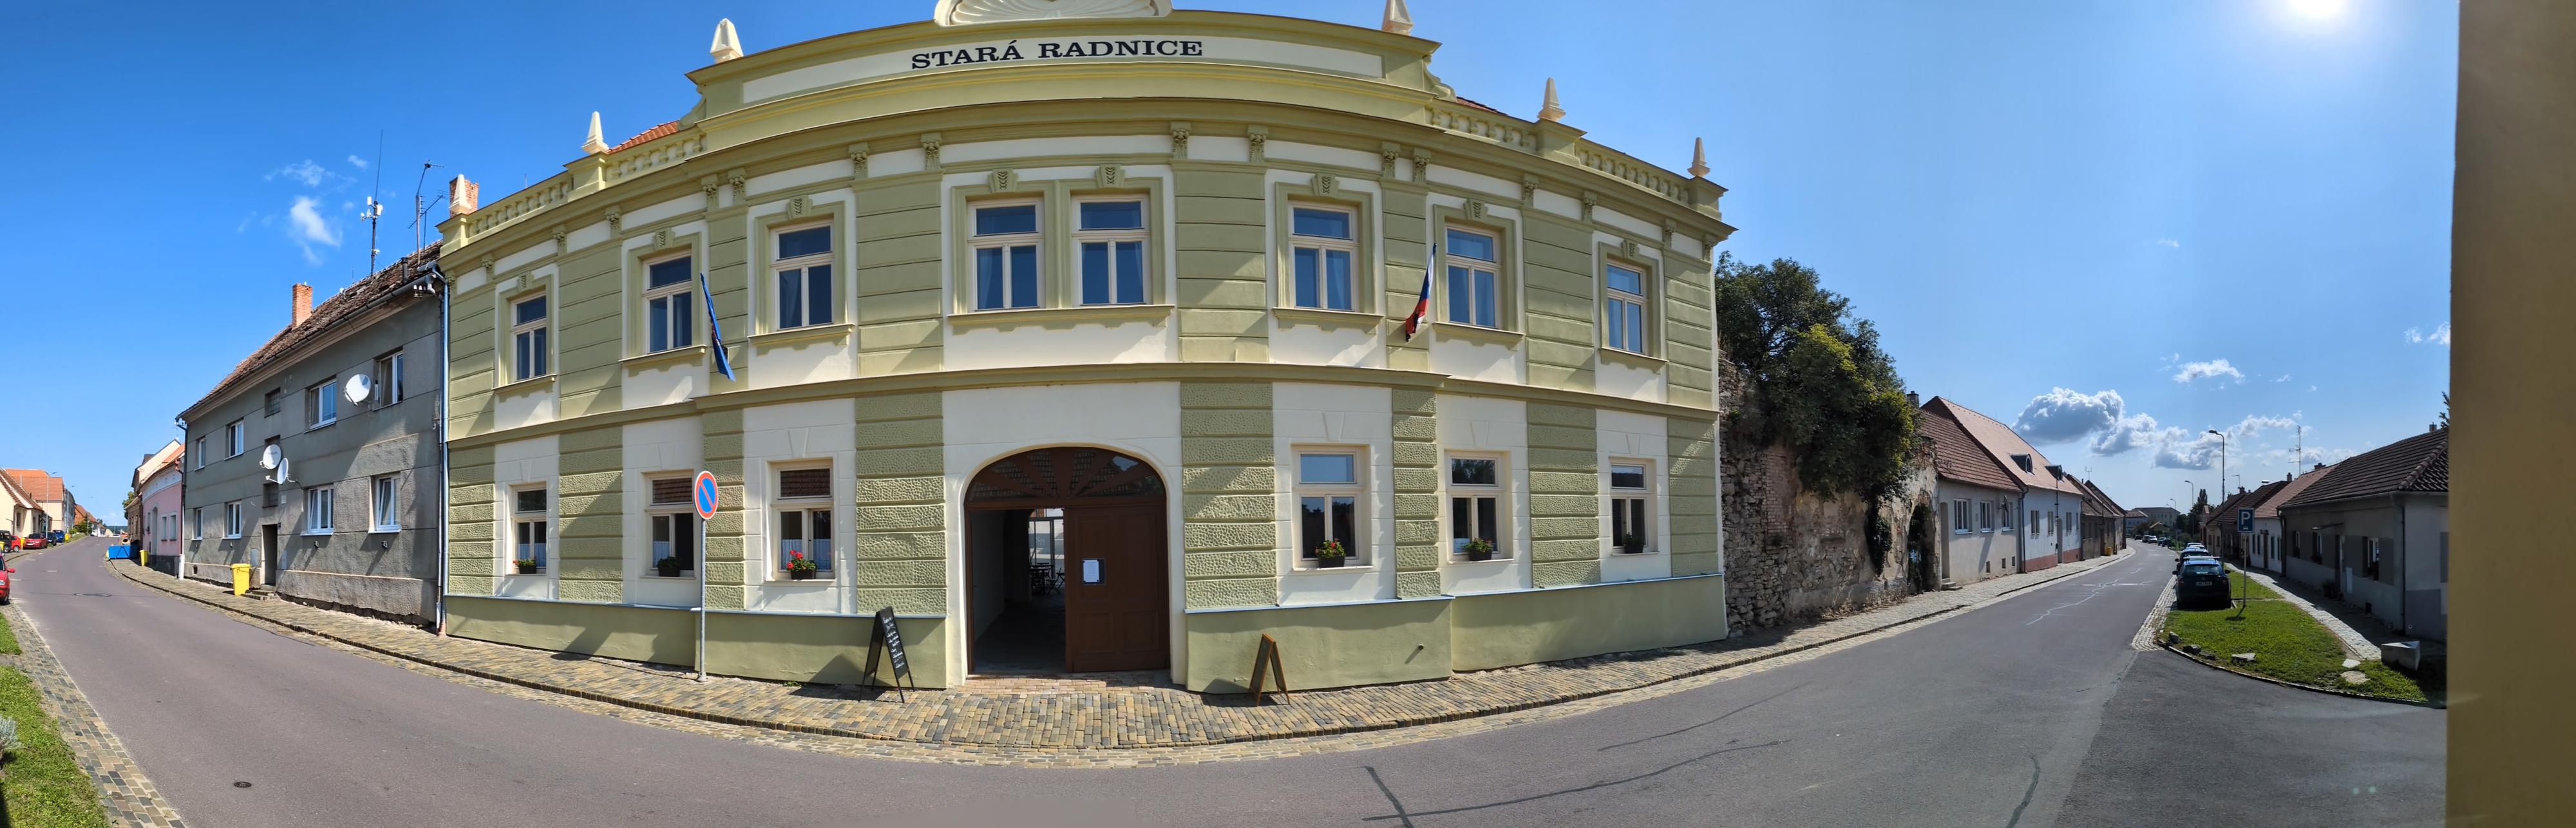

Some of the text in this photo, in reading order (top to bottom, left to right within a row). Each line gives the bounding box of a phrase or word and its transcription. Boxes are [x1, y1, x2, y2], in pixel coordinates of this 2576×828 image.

[911, 40, 1202, 69] STARÁ RADNICE
[2241, 511, 2251, 525] P
